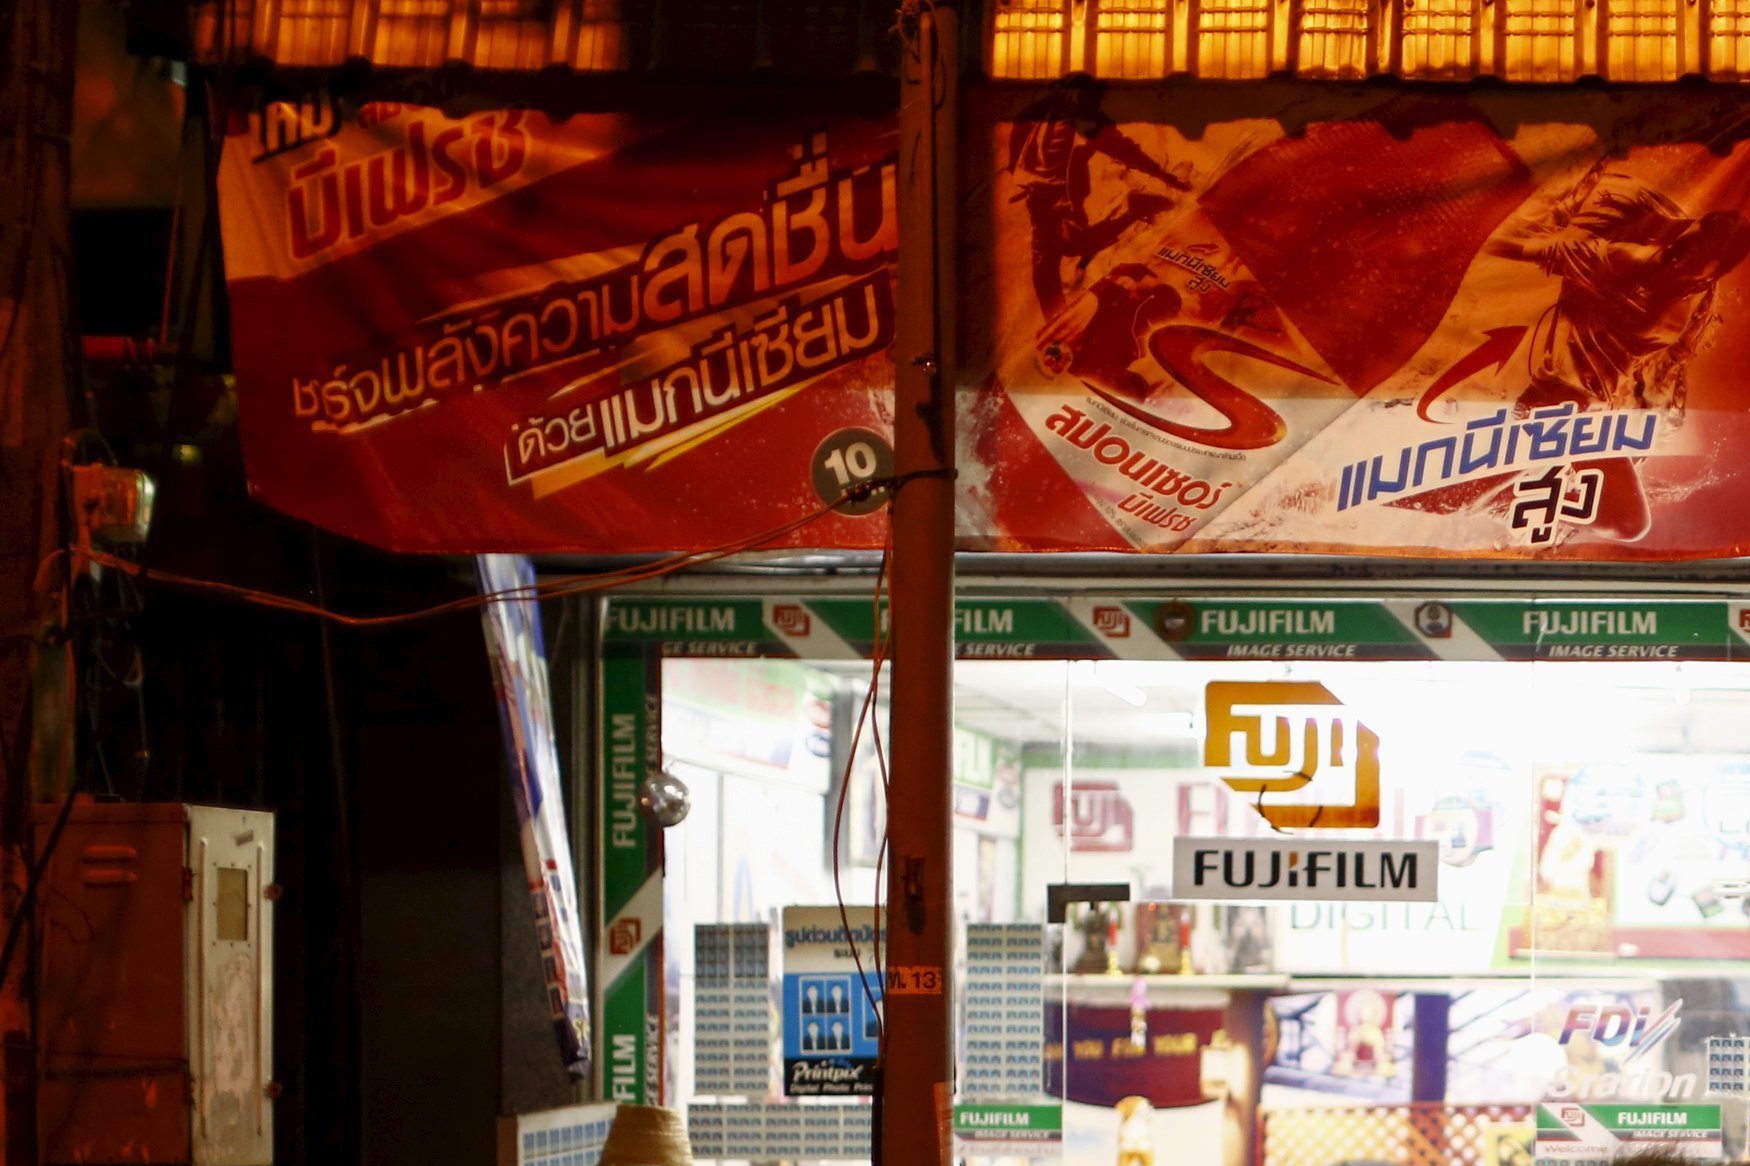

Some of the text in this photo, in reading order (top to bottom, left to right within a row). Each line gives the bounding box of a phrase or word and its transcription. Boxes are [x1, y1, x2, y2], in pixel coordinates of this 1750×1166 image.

[823, 441, 879, 485] 10
[1336, 403, 1657, 512] แมกนีเซียม
[1511, 464, 1599, 545] สูง
[603, 605, 736, 634] FUJIFILM
[1202, 609, 1335, 635] FUJIFILM
[1522, 609, 1657, 636] FUJIFILM
[687, 641, 757, 656] SERVICE
[1226, 643, 1357, 658] IMAGE SERVICE
[1548, 644, 1679, 659] IMAGE SERVICE
[611, 712, 637, 849] FUJIFILM
[1193, 849, 1418, 889] FUJIFILM
[1290, 902, 1480, 931] DIGITAL
[912, 971, 937, 989] 13
[612, 1034, 636, 1104] FILM
[790, 1060, 865, 1082] Printpix
[1547, 1063, 1698, 1099] Station
[959, 1111, 1030, 1127] FUJIFILM
[1617, 1111, 1688, 1126] FUJIFILM
[1632, 1129, 1666, 1138] IMAGE
[1544, 1142, 1608, 1154] Welcome
